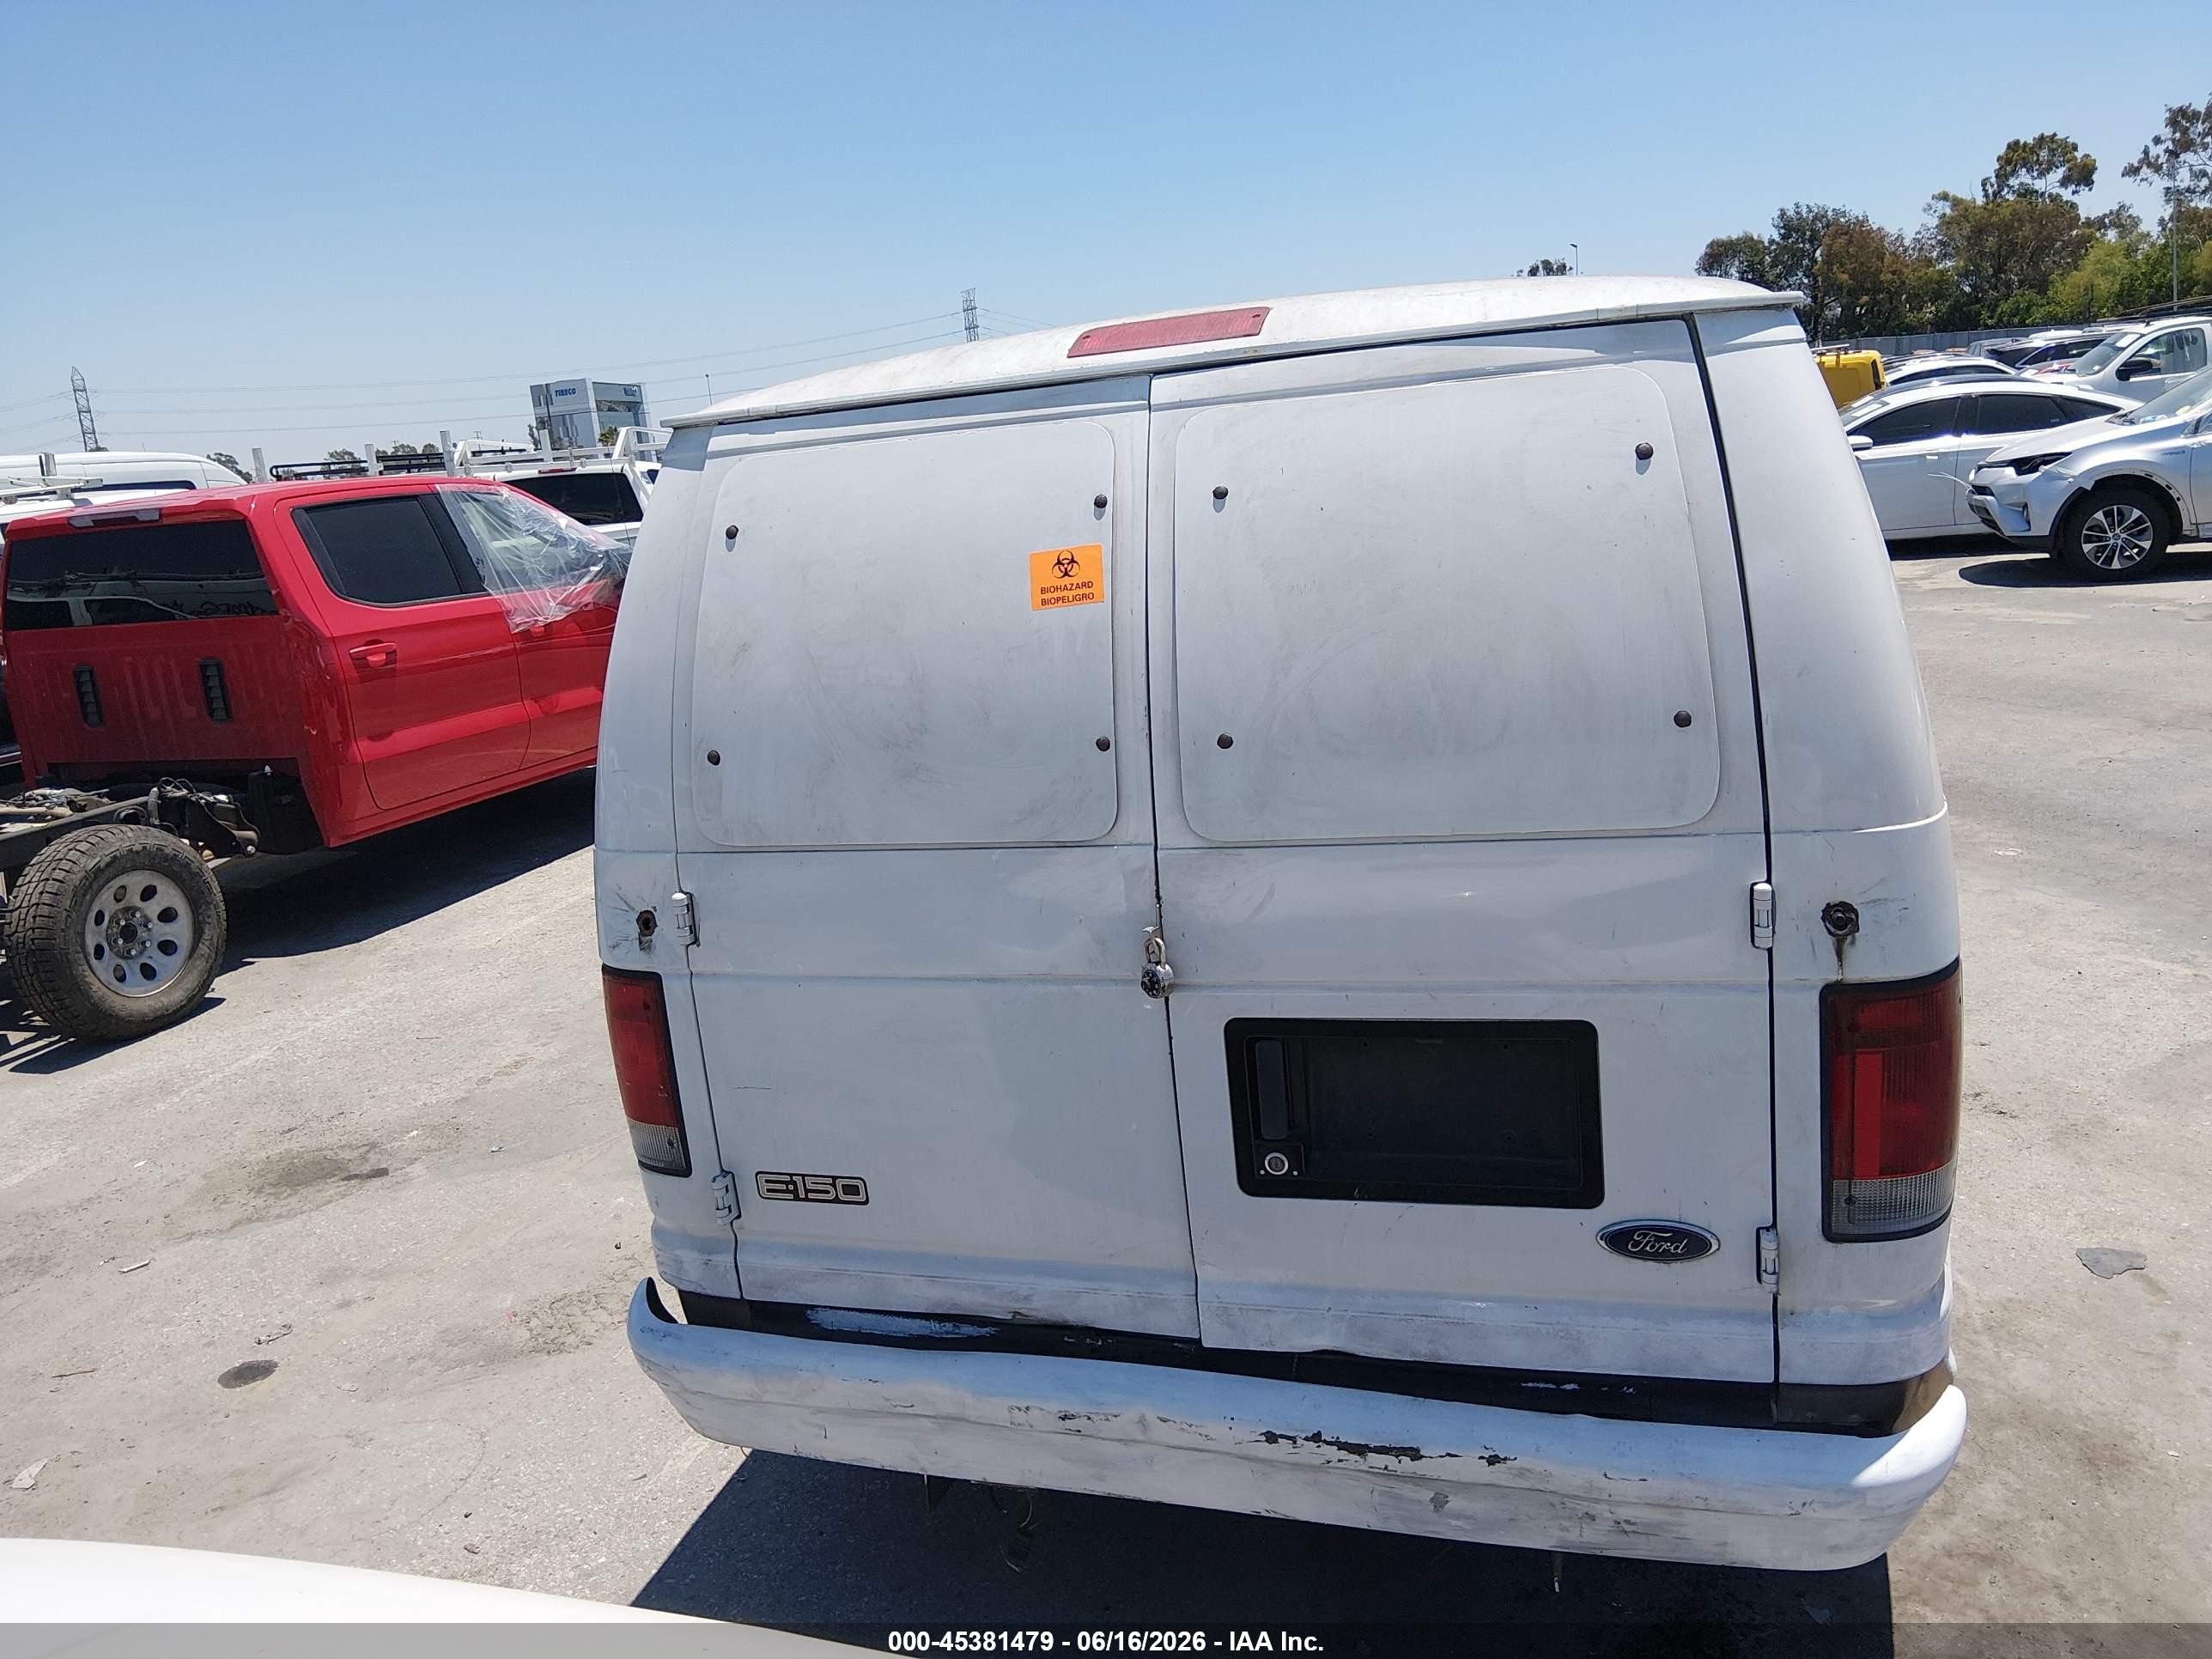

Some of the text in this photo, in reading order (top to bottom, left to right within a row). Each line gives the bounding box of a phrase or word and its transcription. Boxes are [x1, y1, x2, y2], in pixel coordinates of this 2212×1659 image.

[555, 387, 577, 398] TIRECO
[1040, 580, 1094, 595] BIOHAZARD
[1041, 592, 1095, 606] BIOPELIGRO
[1628, 1230, 1688, 1254] Ford
